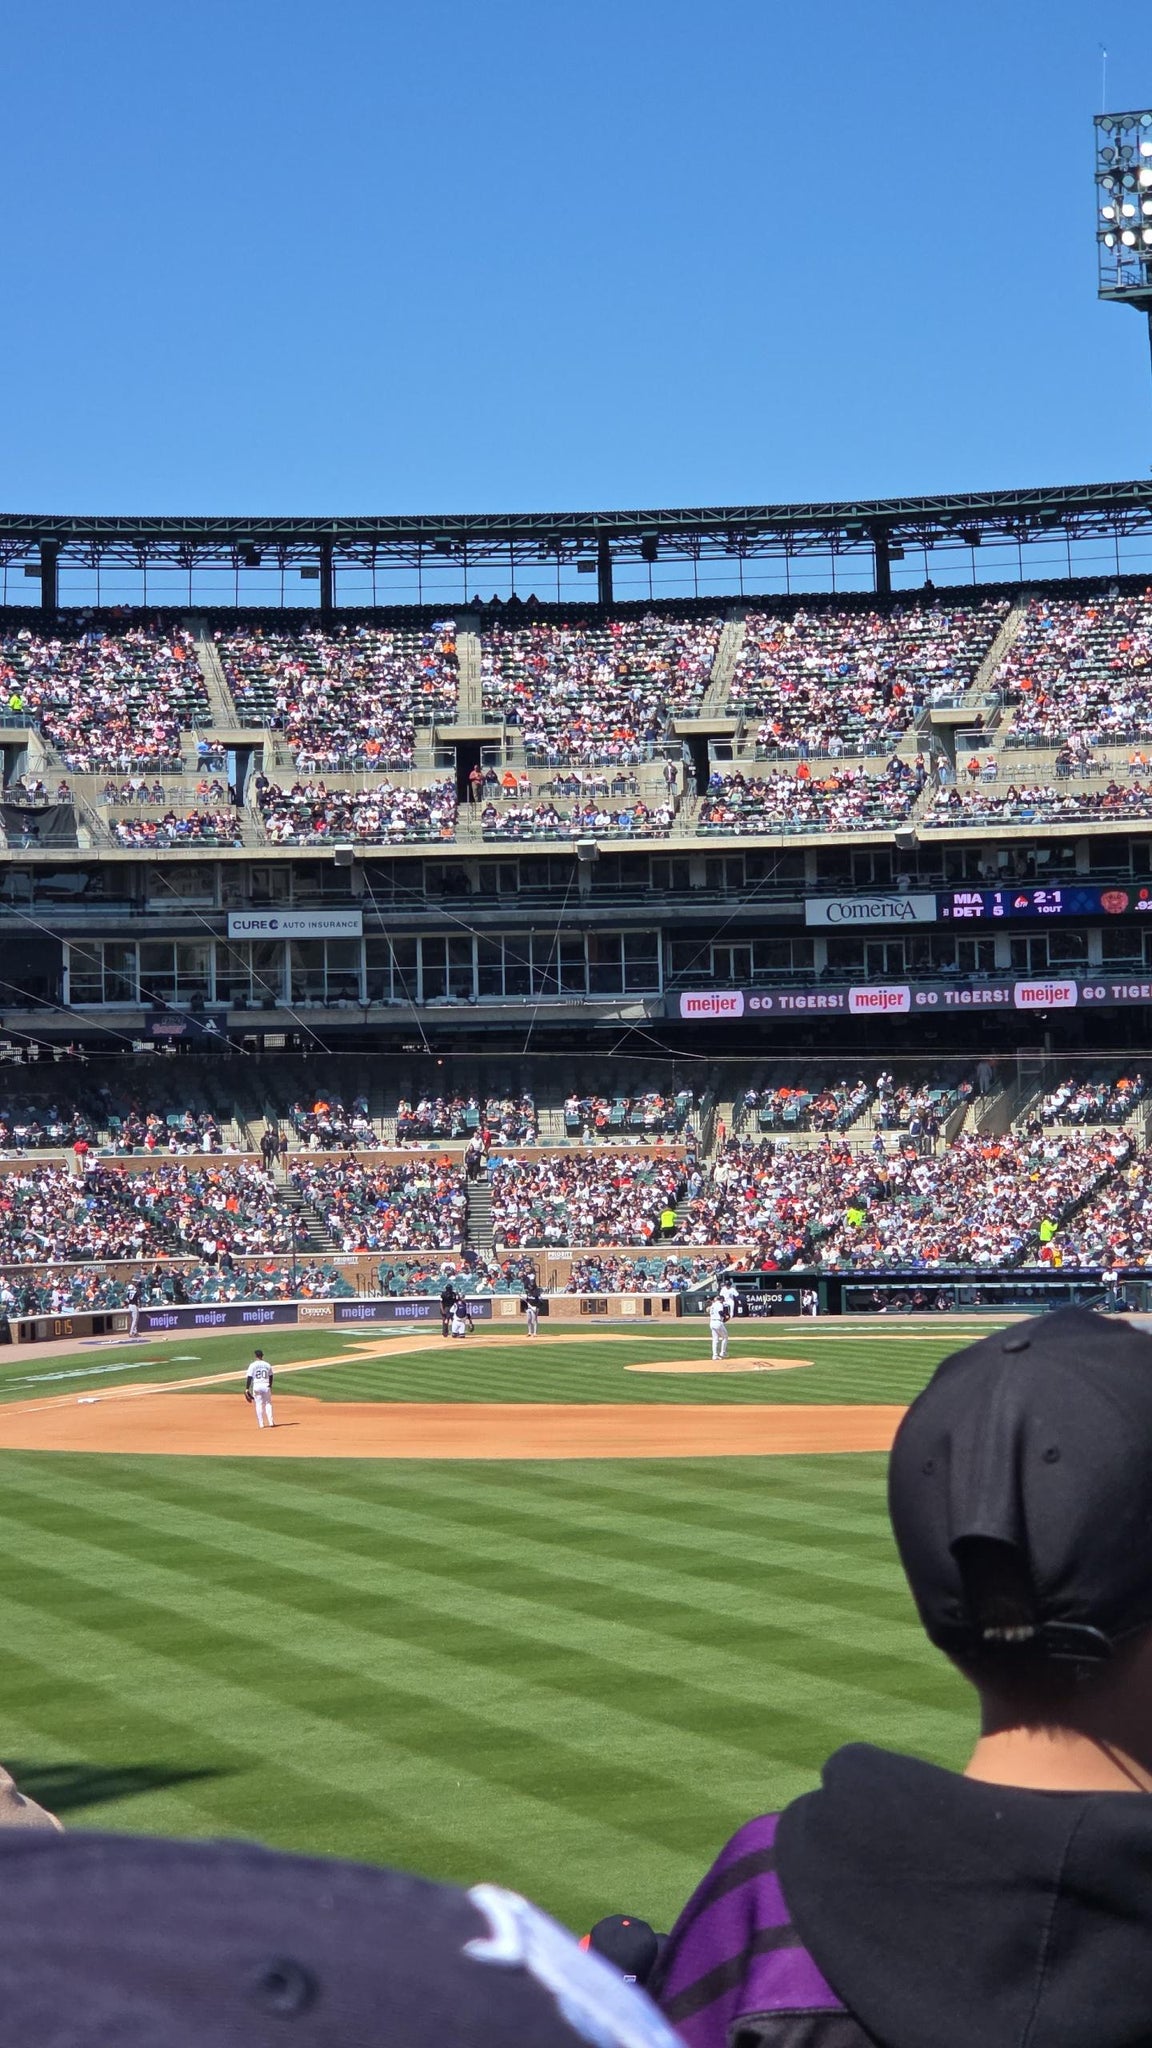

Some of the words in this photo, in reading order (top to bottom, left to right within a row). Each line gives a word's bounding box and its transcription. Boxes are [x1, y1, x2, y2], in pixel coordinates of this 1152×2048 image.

[954, 894, 983, 904] MIA
[994, 893, 1001, 903] 1
[1033, 891, 1061, 903] 2-1
[953, 906, 984, 917] DET
[993, 906, 1004, 916] 5
[233, 920, 267, 930] CURE
[283, 921, 305, 929] AUTO
[308, 920, 358, 928] INSURANCE
[855, 990, 903, 1009] meijer
[915, 992, 938, 1004] GO
[944, 989, 1009, 1004] TIGERS!
[1021, 985, 1070, 1004] meijer
[1083, 987, 1106, 999] GO
[687, 995, 737, 1014] meijer
[749, 997, 773, 1009] GO
[779, 995, 843, 1008] TIGERS!
[243, 1308, 275, 1323] meijer
[341, 1306, 376, 1319] meijer
[394, 1304, 430, 1317] meijer
[150, 1314, 179, 1328] meijer
[195, 1311, 227, 1325] meijer
[255, 1370, 267, 1379] 20
